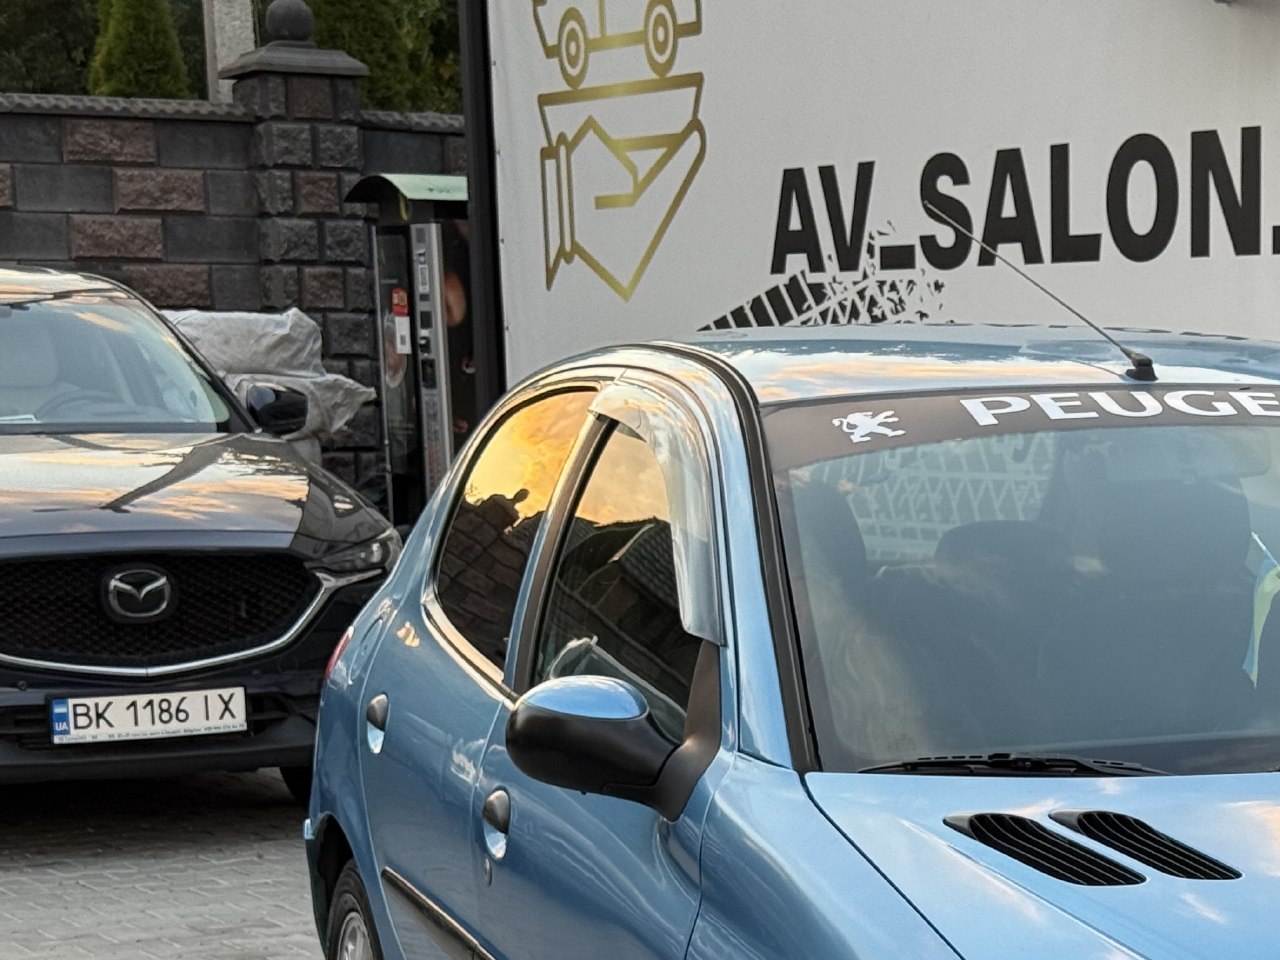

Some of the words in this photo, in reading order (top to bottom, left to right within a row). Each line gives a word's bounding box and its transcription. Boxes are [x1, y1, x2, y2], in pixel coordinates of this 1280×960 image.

[72, 701, 115, 731] BK
[126, 696, 190, 727] 1186
[55, 721, 69, 731] UA
